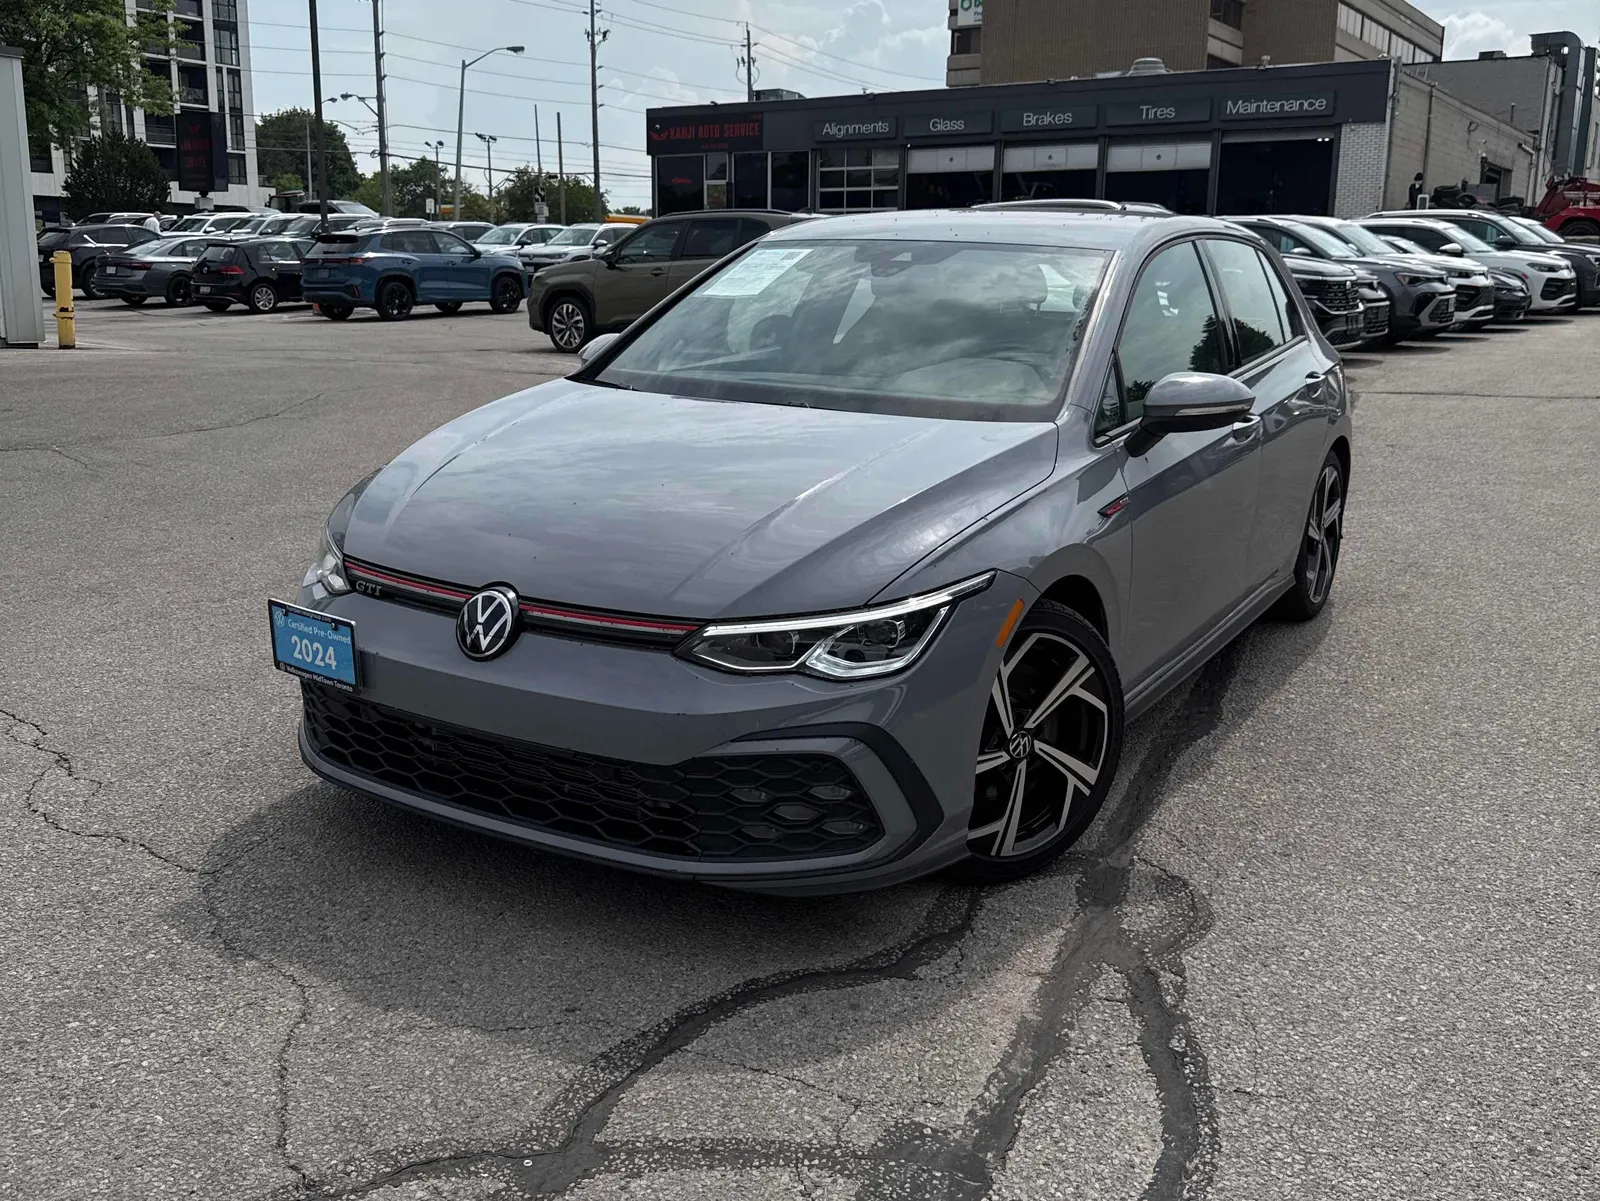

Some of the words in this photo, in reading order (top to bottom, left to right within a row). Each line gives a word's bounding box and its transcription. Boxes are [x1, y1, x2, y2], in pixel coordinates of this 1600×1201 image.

[1139, 105, 1175, 120] Tires
[1226, 98, 1326, 115] Maintenance
[929, 118, 965, 132] Glass
[1022, 111, 1073, 127] Brakes
[669, 124, 695, 140] KANJI
[698, 124, 720, 139] AUTO
[724, 122, 760, 137] SERVICE
[822, 120, 890, 139] Alignments
[355, 580, 382, 597] GTI
[287, 618, 313, 635] Certified
[313, 626, 351, 645] Pre-Owned
[290, 635, 338, 671] 2024
